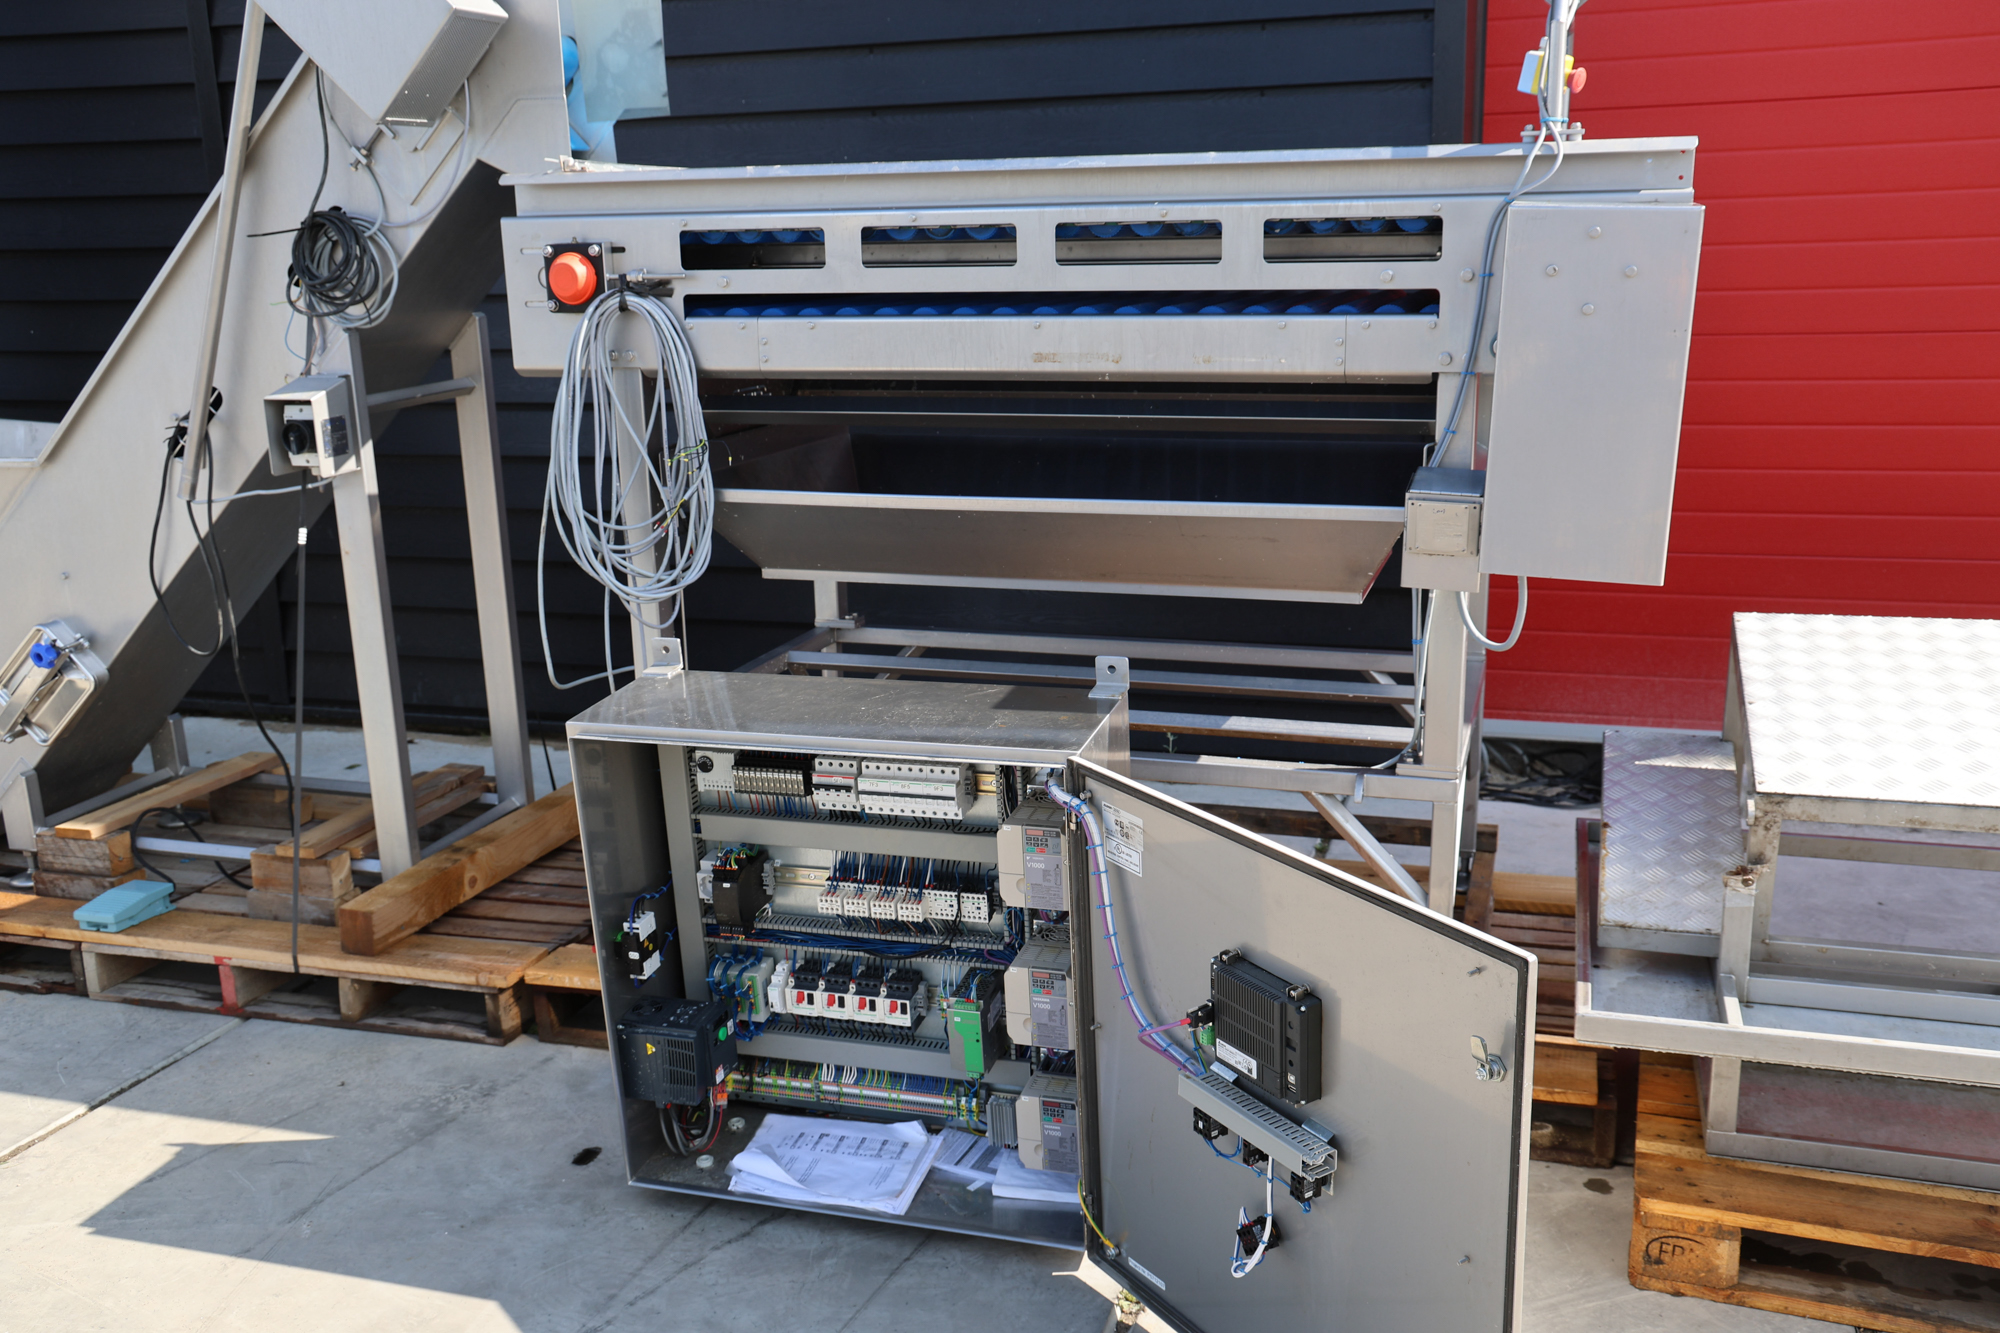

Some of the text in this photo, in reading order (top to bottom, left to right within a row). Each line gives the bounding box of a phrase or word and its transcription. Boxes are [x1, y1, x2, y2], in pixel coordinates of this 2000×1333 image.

[1026, 861, 1045, 869] V1000
[1032, 1002, 1051, 1010] V1000
[1043, 1129, 1062, 1137] V1000
